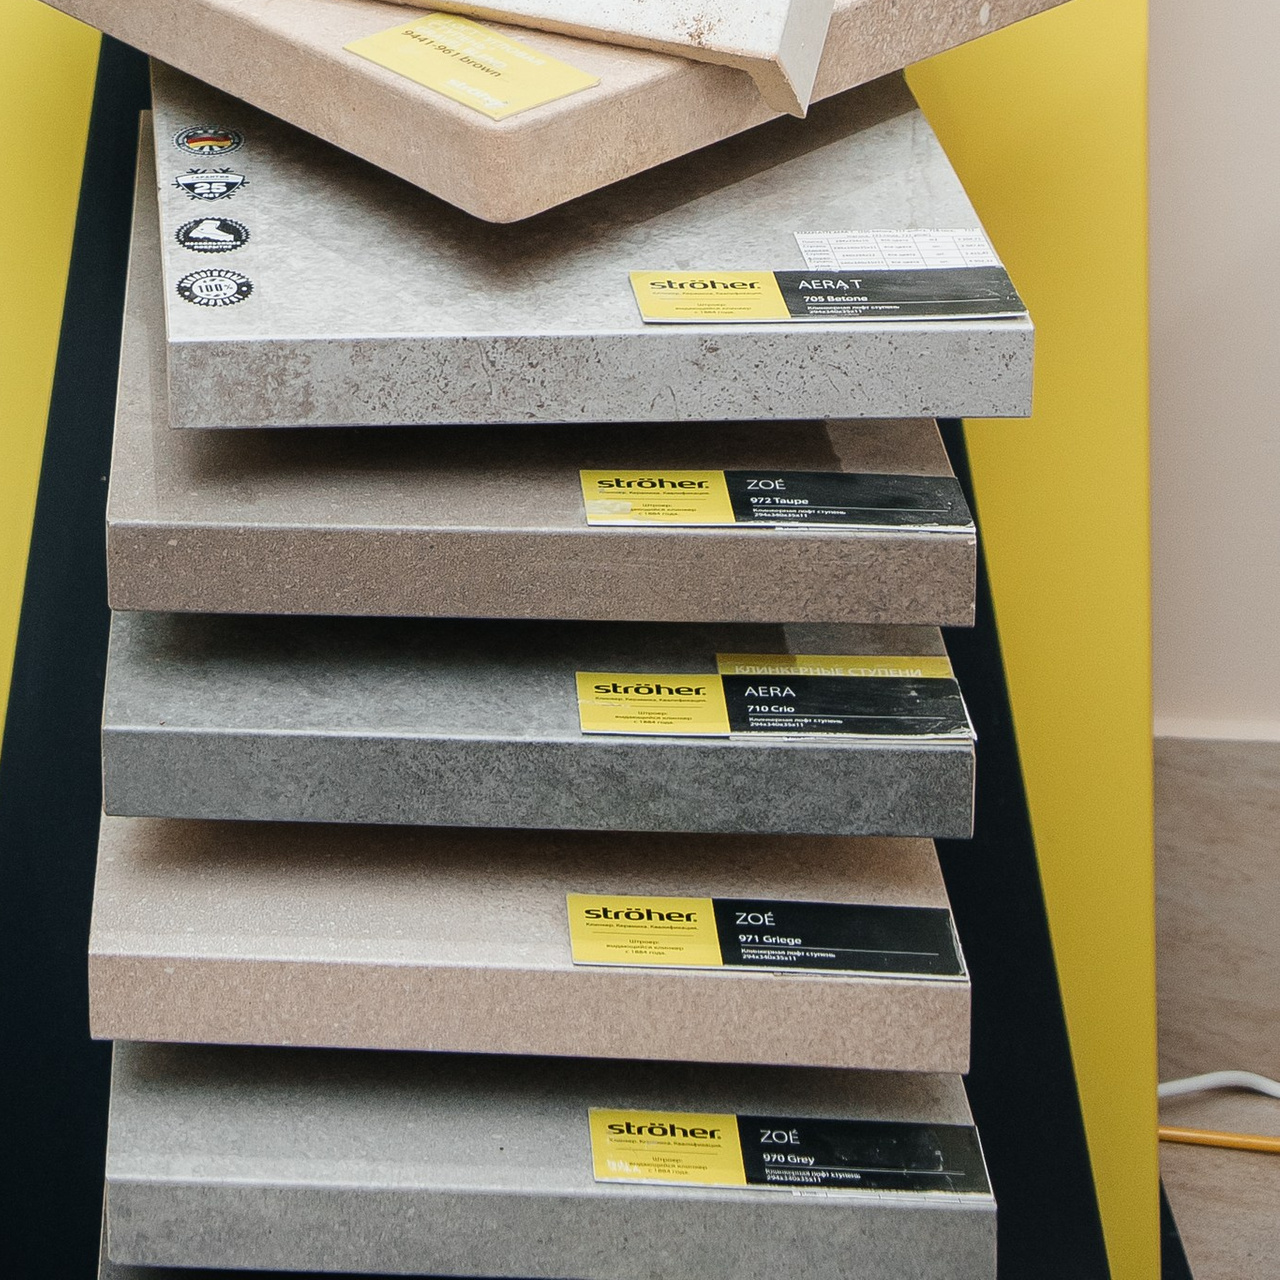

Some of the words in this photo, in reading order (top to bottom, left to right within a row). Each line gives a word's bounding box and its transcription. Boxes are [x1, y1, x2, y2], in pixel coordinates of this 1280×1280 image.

[401, 29, 460, 59] 9441-961
[460, 56, 501, 78] brown
[194, 182, 227, 194] 25
[198, 283, 233, 293] 100%
[798, 279, 849, 289] AERA
[746, 478, 786, 490] ZOÉ
[772, 497, 809, 505] Taupe
[735, 665, 843, 676] КЛИНКЕРНЫЕ
[848, 667, 922, 677] СТУПЕНИ
[744, 686, 796, 697] AERA
[747, 705, 769, 713] 710
[771, 705, 795, 713] Crio
[736, 911, 775, 926] ZOÉ
[738, 934, 759, 943] 971
[762, 935, 802, 946] Griege
[760, 1128, 800, 1145] ZOÉ
[762, 1153, 785, 1163] 970
[787, 1153, 815, 1166] Grey
